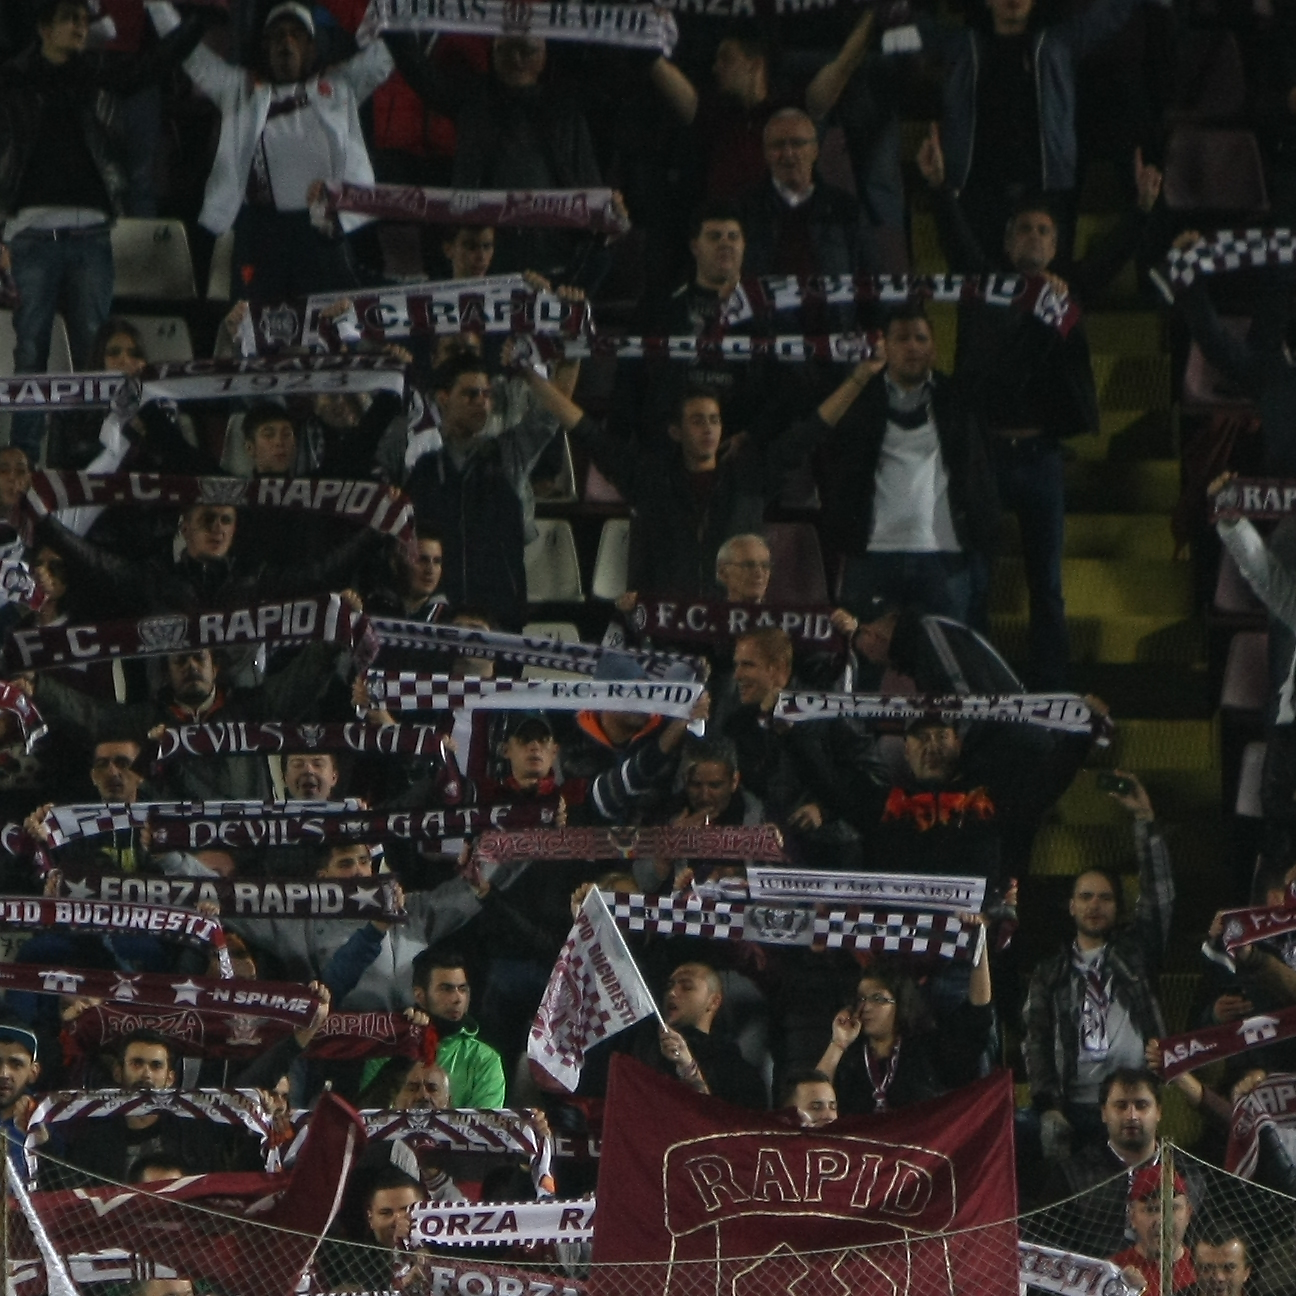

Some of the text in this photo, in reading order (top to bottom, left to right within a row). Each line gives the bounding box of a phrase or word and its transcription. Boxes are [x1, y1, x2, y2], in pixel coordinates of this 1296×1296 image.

[427, 300, 578, 334] RAPID
[83, 470, 377, 514] F.C. RAPID
[13, 599, 318, 669] F.C. RAPID
[655, 602, 717, 632] F.C.
[552, 682, 693, 705] F.C. RAPID
[342, 721, 440, 755] GAT
[188, 807, 515, 849] DEVIL'S GATE
[233, 881, 345, 915] RAPID
[54, 901, 220, 943] BUCURESTI
[232, 989, 314, 1014] SPUME
[587, 942, 637, 1027] BUCURESTI
[684, 1146, 935, 1217] RAPID
[410, 1208, 520, 1237] FORZA
